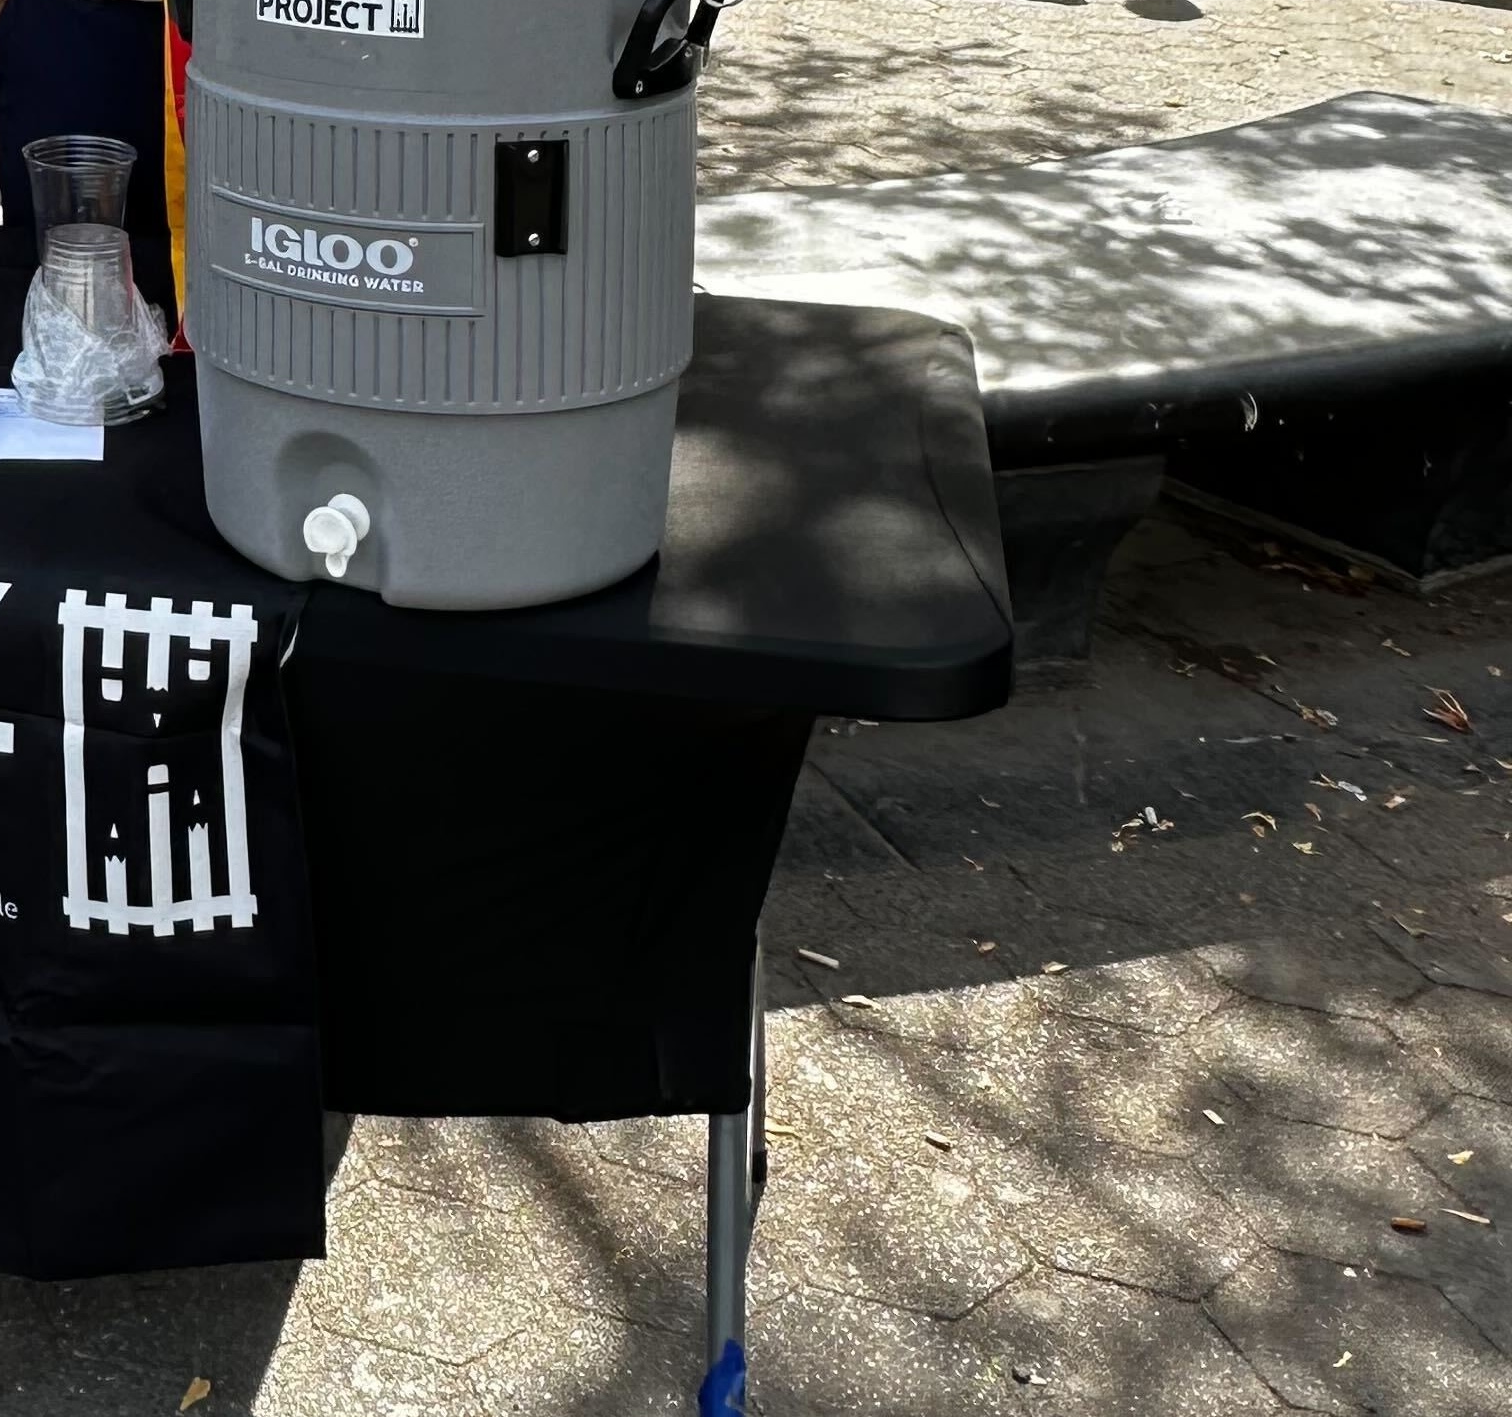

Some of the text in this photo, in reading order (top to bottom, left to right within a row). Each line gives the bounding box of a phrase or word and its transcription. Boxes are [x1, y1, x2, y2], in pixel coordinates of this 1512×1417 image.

[251, 216, 414, 276] IGLOO
[287, 264, 360, 288] DRINKING
[363, 275, 425, 294] WATER
